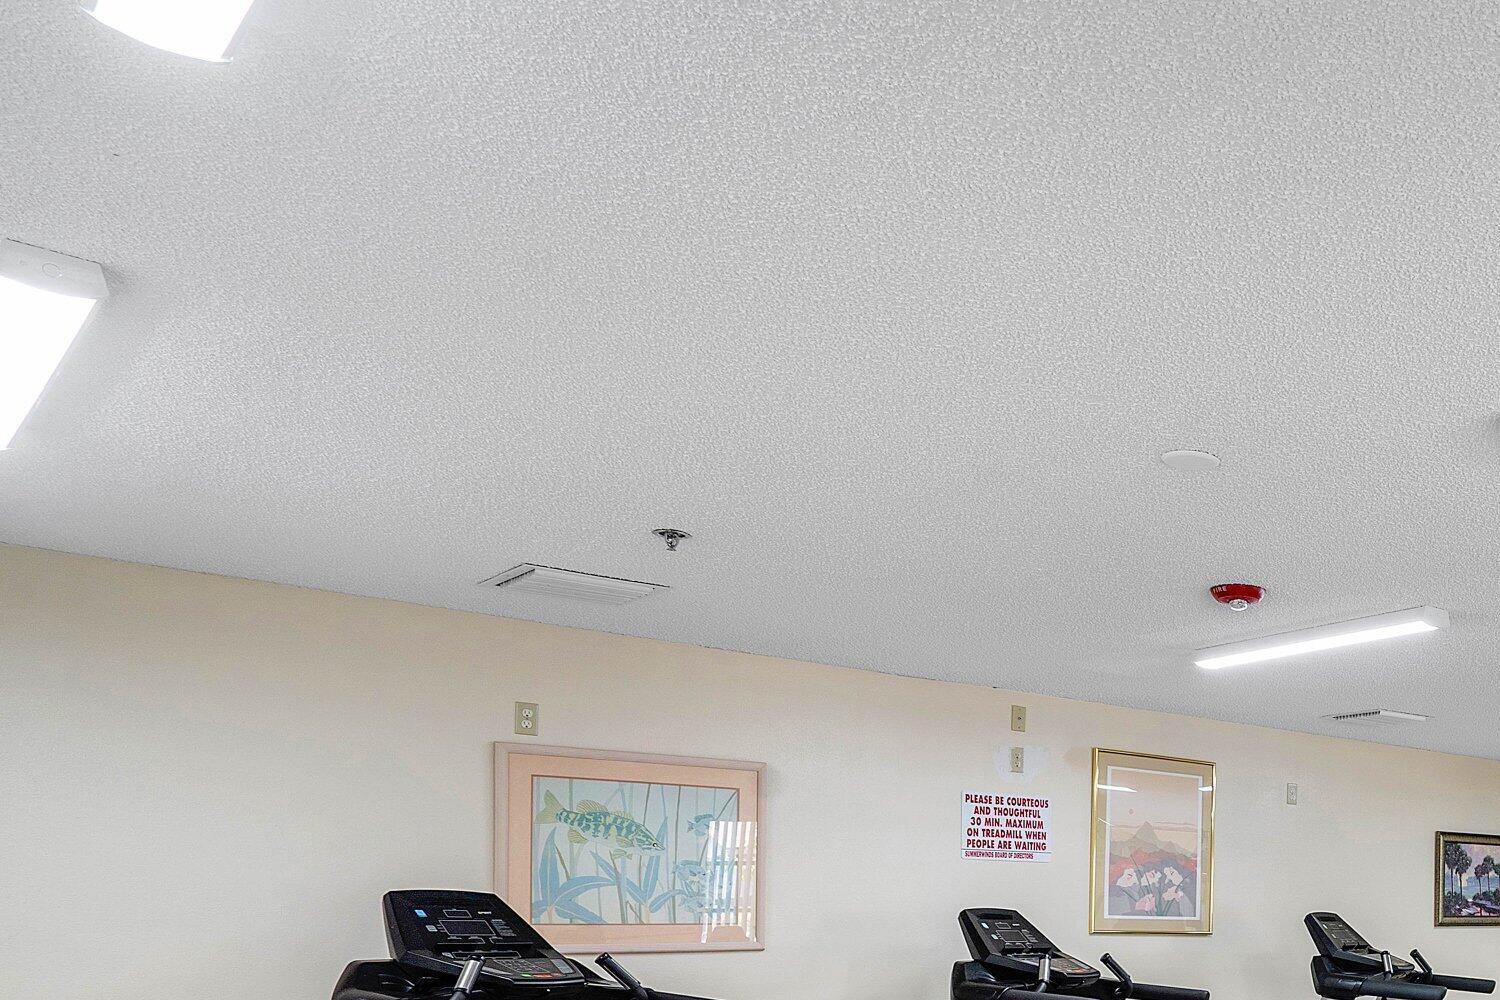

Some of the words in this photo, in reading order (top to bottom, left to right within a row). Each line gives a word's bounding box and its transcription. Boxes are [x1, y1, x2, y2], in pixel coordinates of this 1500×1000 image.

[965, 794, 992, 804] PLEASE
[995, 796, 1004, 805] BE
[1006, 797, 1049, 808] COURTEOUS
[973, 806, 991, 815] AND
[993, 807, 1041, 818] THOUGHTFUL
[970, 817, 981, 825] 30
[984, 818, 1003, 827] MIN.
[1005, 819, 1044, 829] MAXIMUM
[966, 828, 979, 837] ON
[981, 829, 1022, 839] TREADMILL
[1025, 831, 1047, 840] WHEN
[966, 839, 995, 848] PEOPLE
[997, 840, 1012, 849] ARE
[1014, 841, 1047, 851] WAITING
